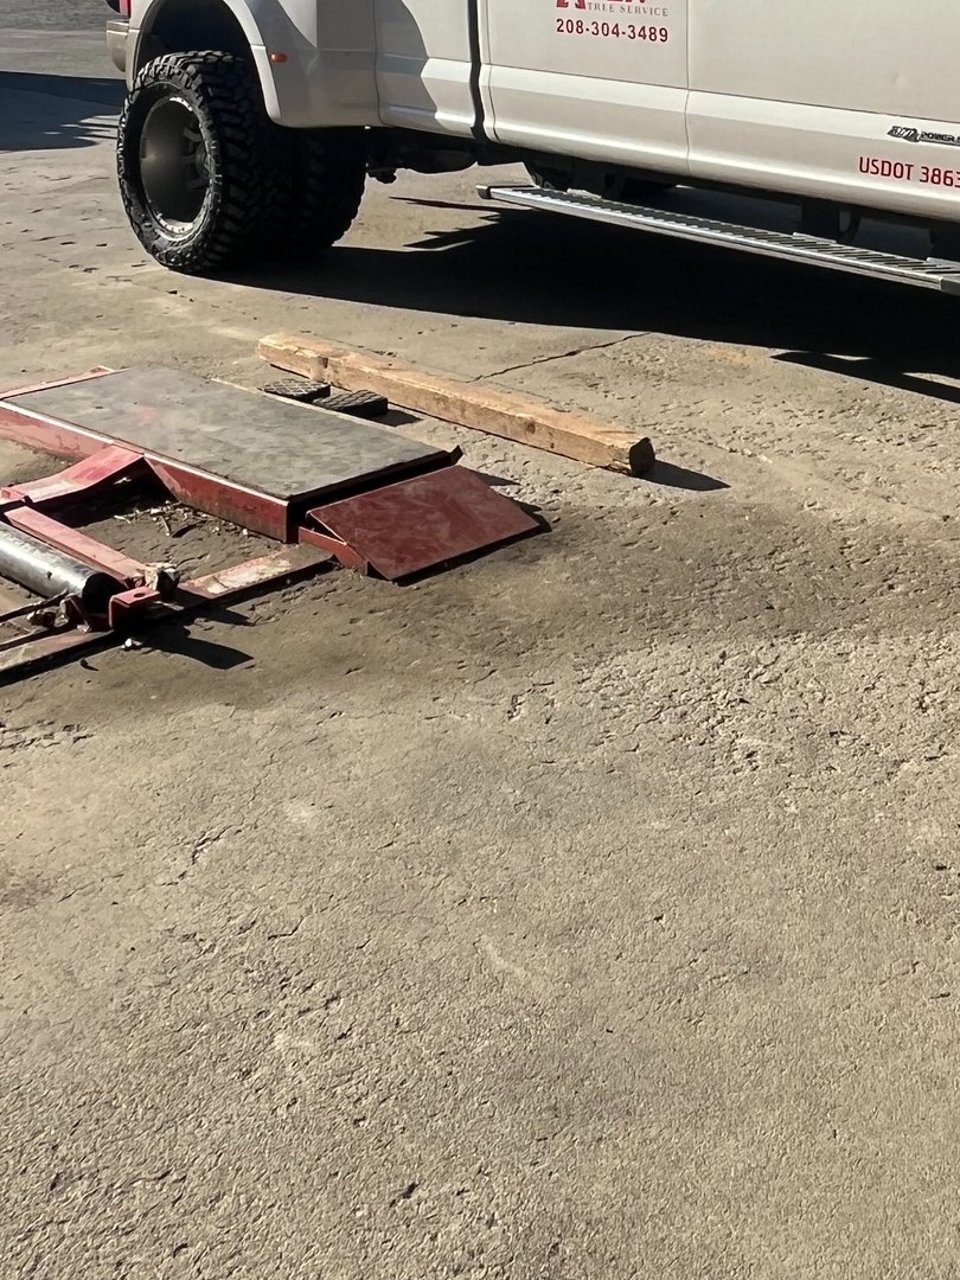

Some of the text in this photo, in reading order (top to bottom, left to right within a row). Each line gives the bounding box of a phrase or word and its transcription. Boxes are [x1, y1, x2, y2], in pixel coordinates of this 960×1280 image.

[588, 2, 668, 17] TREE SERVICE
[556, 18, 668, 42] 208-304-3489
[859, 156, 914, 181] USDOT
